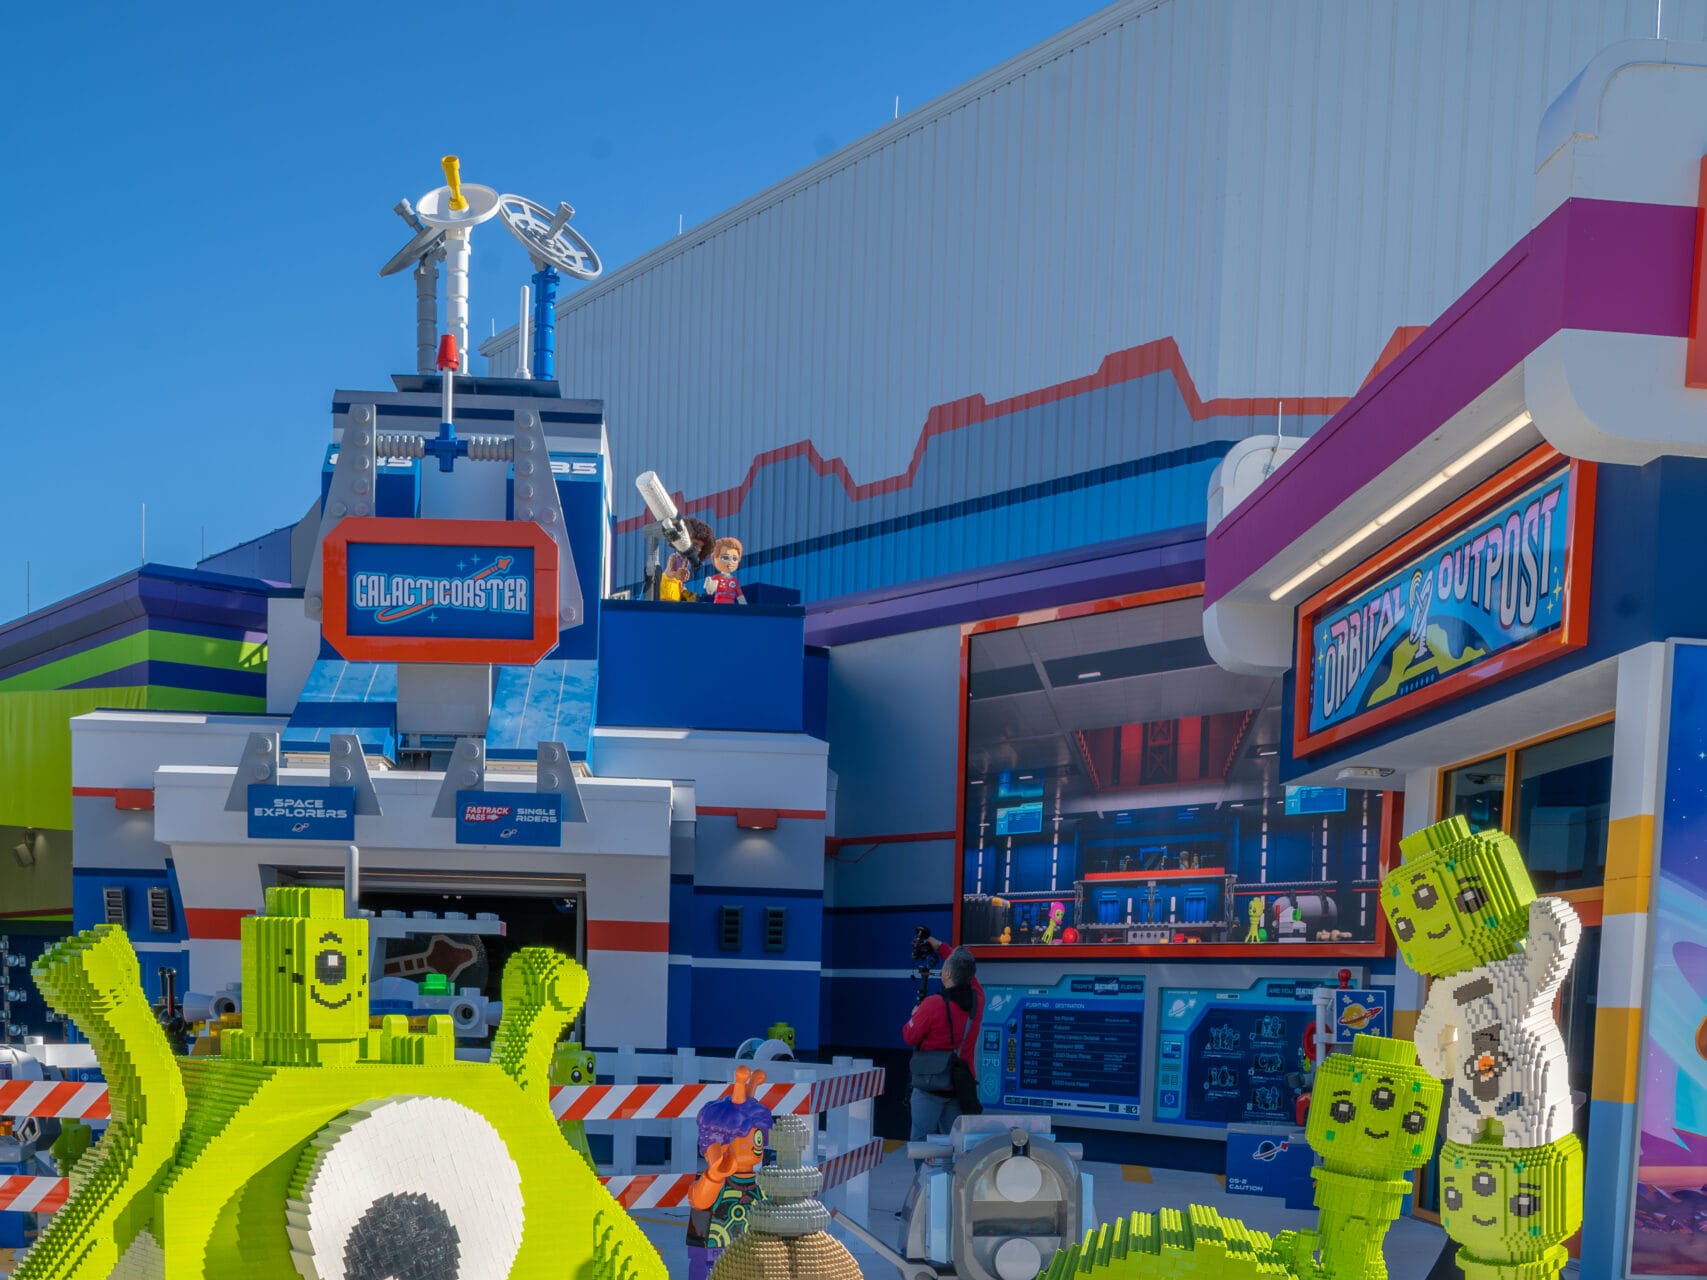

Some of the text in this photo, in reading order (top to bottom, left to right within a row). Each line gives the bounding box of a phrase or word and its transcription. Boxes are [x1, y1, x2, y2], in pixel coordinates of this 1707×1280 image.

[354, 573, 528, 612] GALACTICOASTER
[1322, 487, 1563, 720] ORBITAL OUTPOST
[273, 798, 324, 808] SPACE
[253, 807, 348, 819] EXPLORERS
[466, 805, 510, 815] FASTRACK
[517, 808, 557, 816] SINGLE
[465, 813, 486, 821] PASS
[515, 815, 558, 824] RIDERS
[1229, 1183, 1264, 1192] CAUTION
